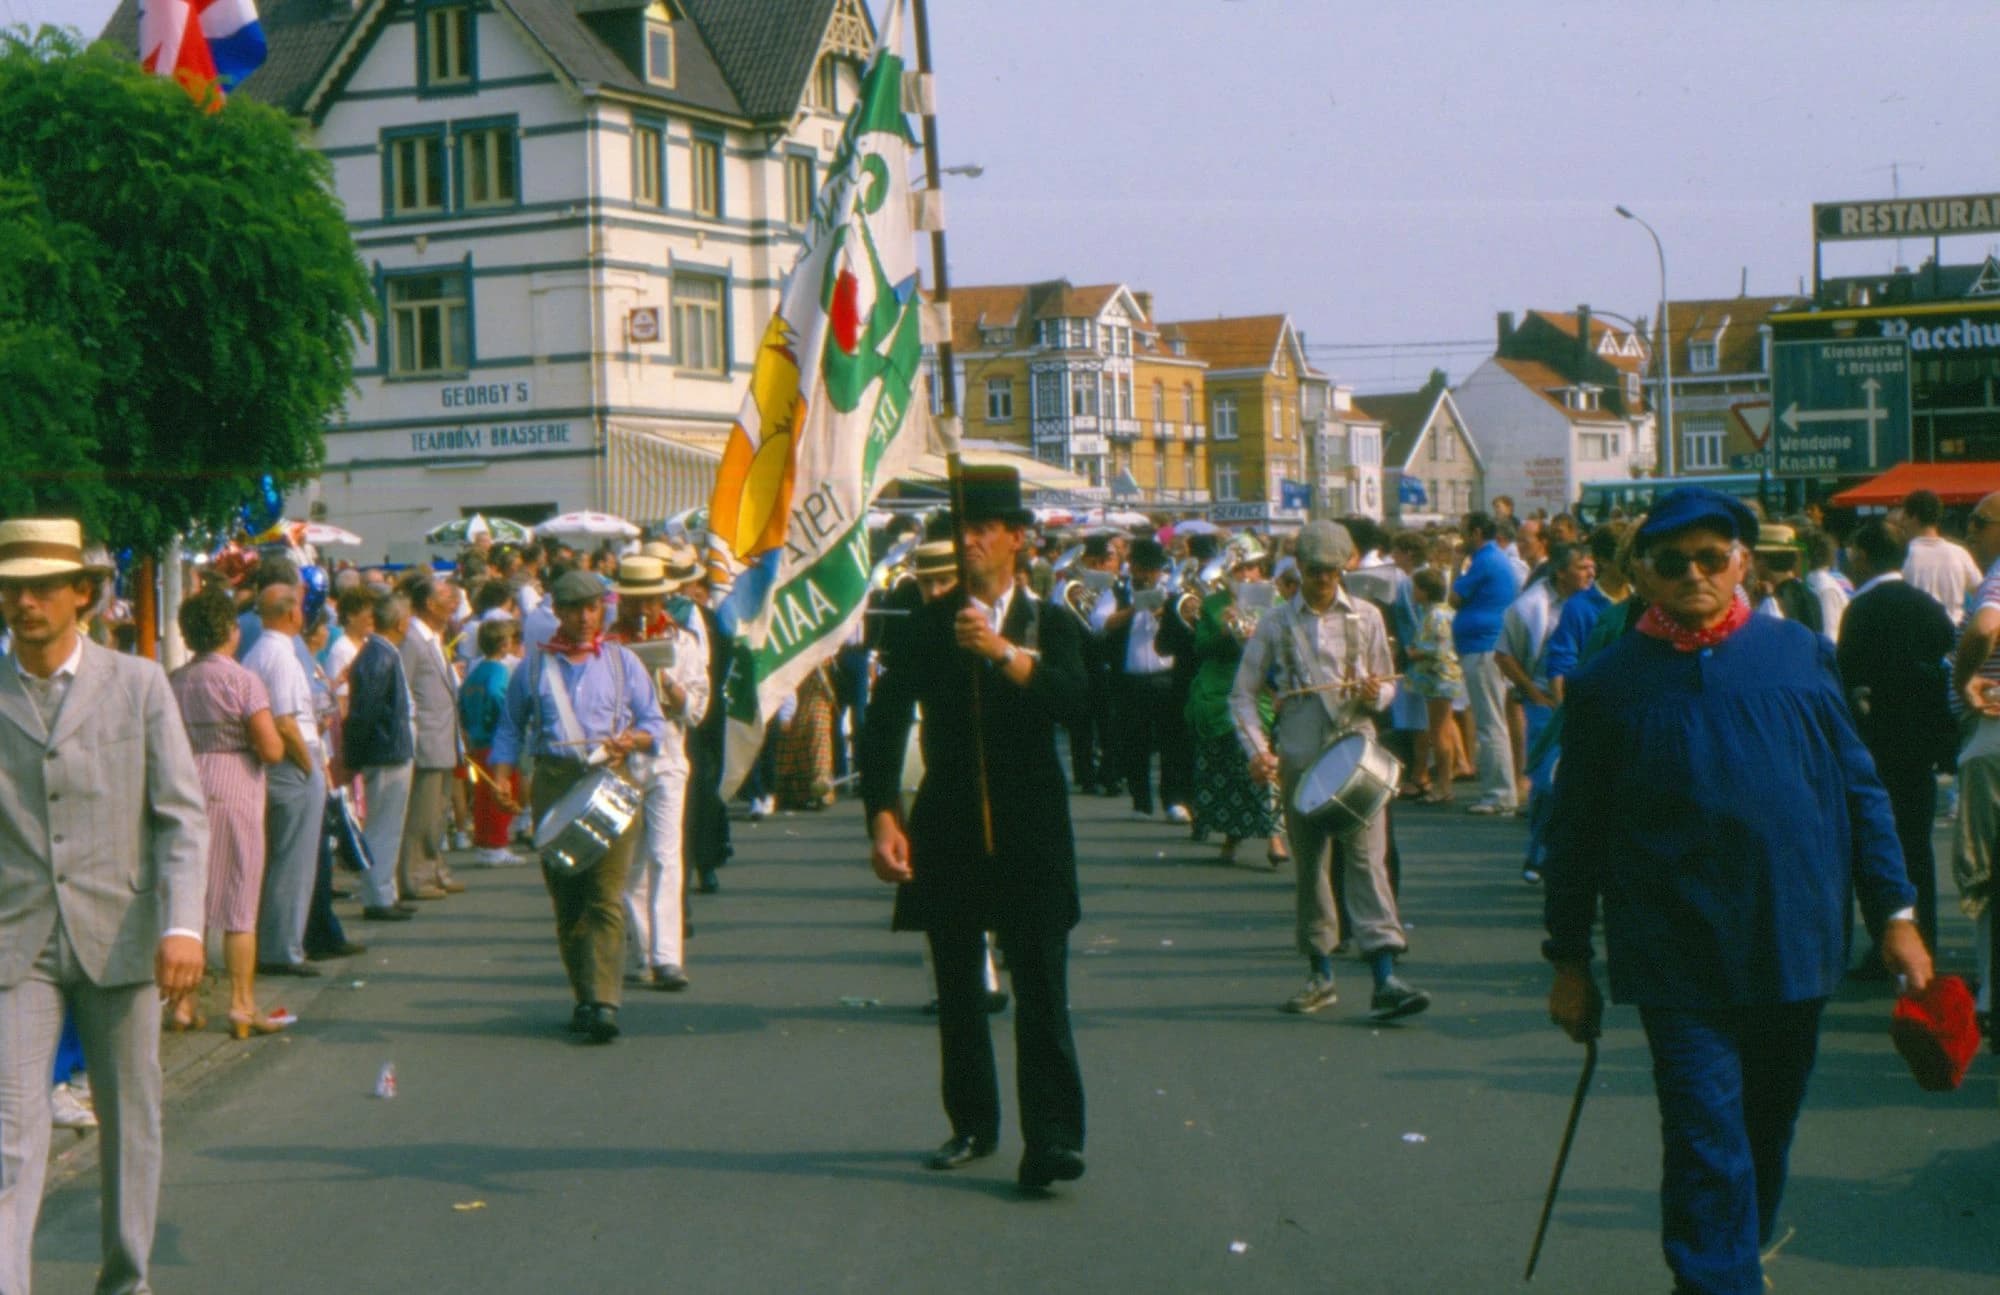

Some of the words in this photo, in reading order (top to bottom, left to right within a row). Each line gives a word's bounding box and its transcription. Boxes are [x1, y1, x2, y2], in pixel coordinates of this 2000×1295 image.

[490, 423, 570, 447] BRASSERIE
[1778, 434, 1852, 452] Wenduine
[1778, 455, 1838, 472] Knokke
[1213, 503, 1267, 520] SERVICE
